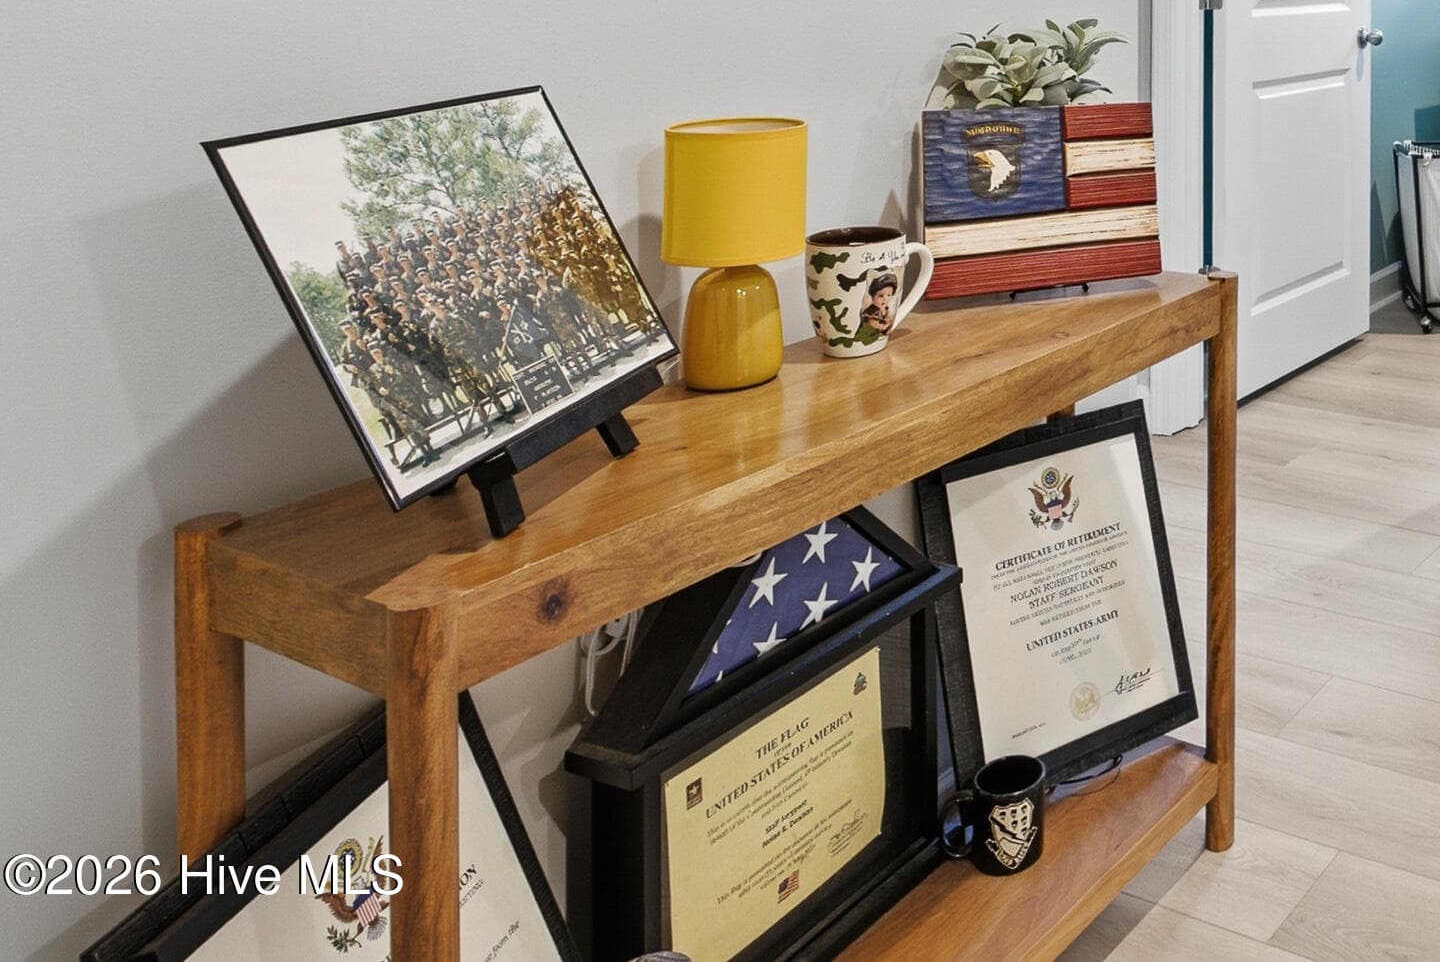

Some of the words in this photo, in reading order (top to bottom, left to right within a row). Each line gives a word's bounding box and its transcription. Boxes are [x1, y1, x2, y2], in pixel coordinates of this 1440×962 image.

[995, 545, 1053, 572] CERTIFICATE
[1067, 522, 1121, 547] RETIREMENT
[1010, 585, 1042, 604] NOLAN
[1028, 592, 1056, 610] STAFF
[1026, 631, 1062, 652] UNITED
[1062, 620, 1094, 638] STATES
[755, 739, 779, 760] THE
[780, 717, 810, 744] FLAG
[705, 782, 749, 819] UNITED
[750, 753, 790, 787] STATES
[791, 742, 807, 759] OF
[806, 711, 854, 746] AMERICA
